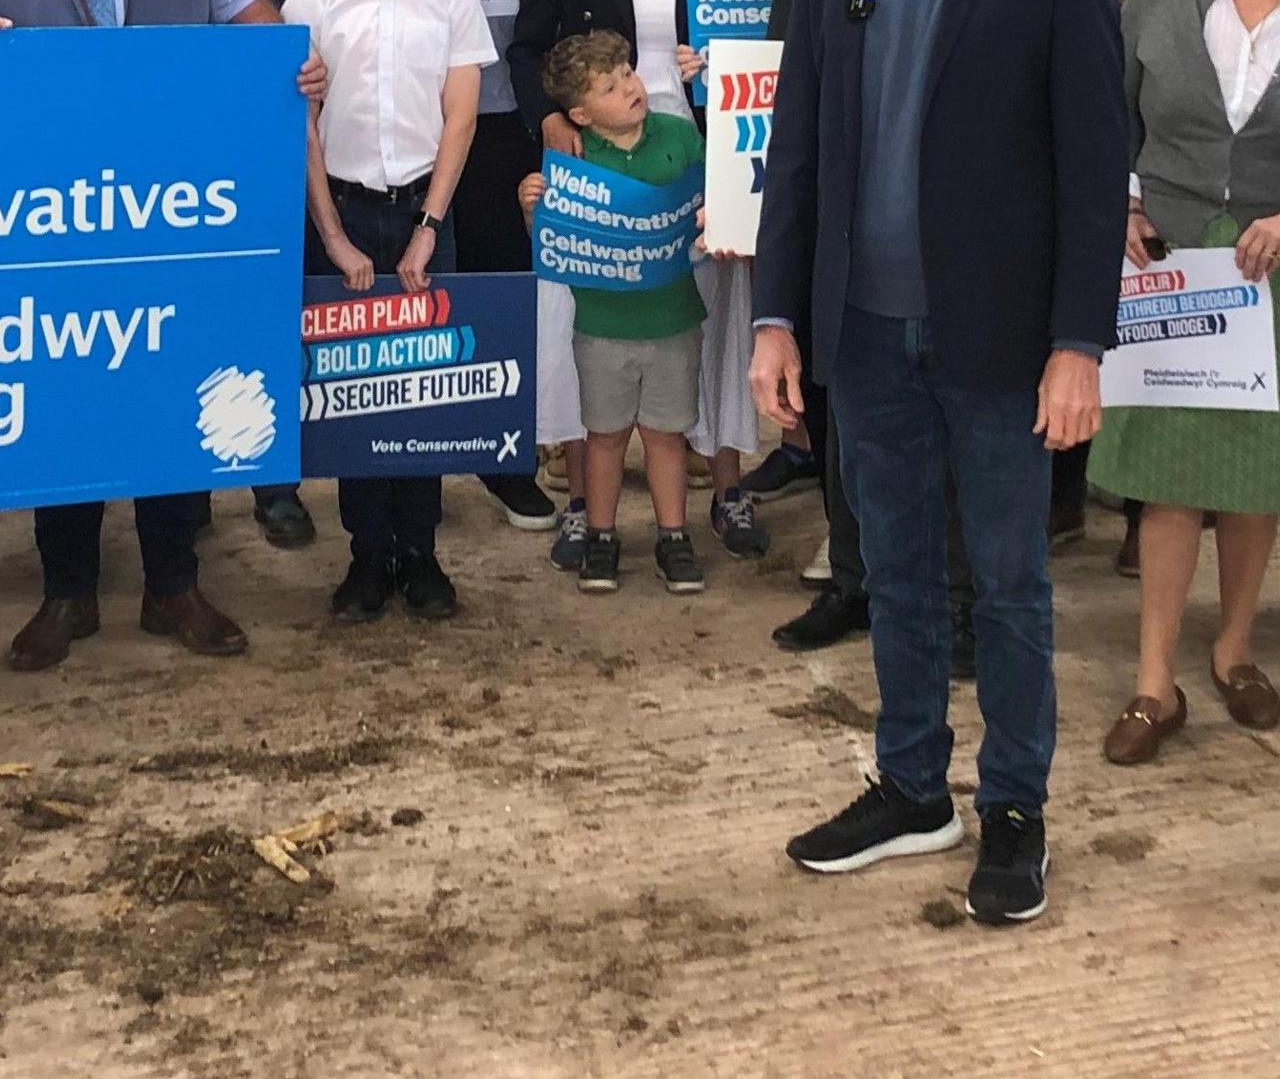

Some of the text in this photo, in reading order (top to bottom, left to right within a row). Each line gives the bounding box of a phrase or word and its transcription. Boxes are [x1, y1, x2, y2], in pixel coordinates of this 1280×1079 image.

[550, 163, 612, 206] Welsh
[543, 189, 704, 232] Conservatives
[539, 227, 685, 263] Ceidwadwyr
[539, 247, 642, 283] Cymreig
[301, 295, 426, 337] CLEAR PLAN
[1116, 323, 1166, 344] YFODOL
[317, 333, 452, 375] BOLD ACTION
[332, 366, 497, 412] SECURE FUTURE
[371, 439, 402, 453] Vote
[406, 437, 498, 453] Conservative
